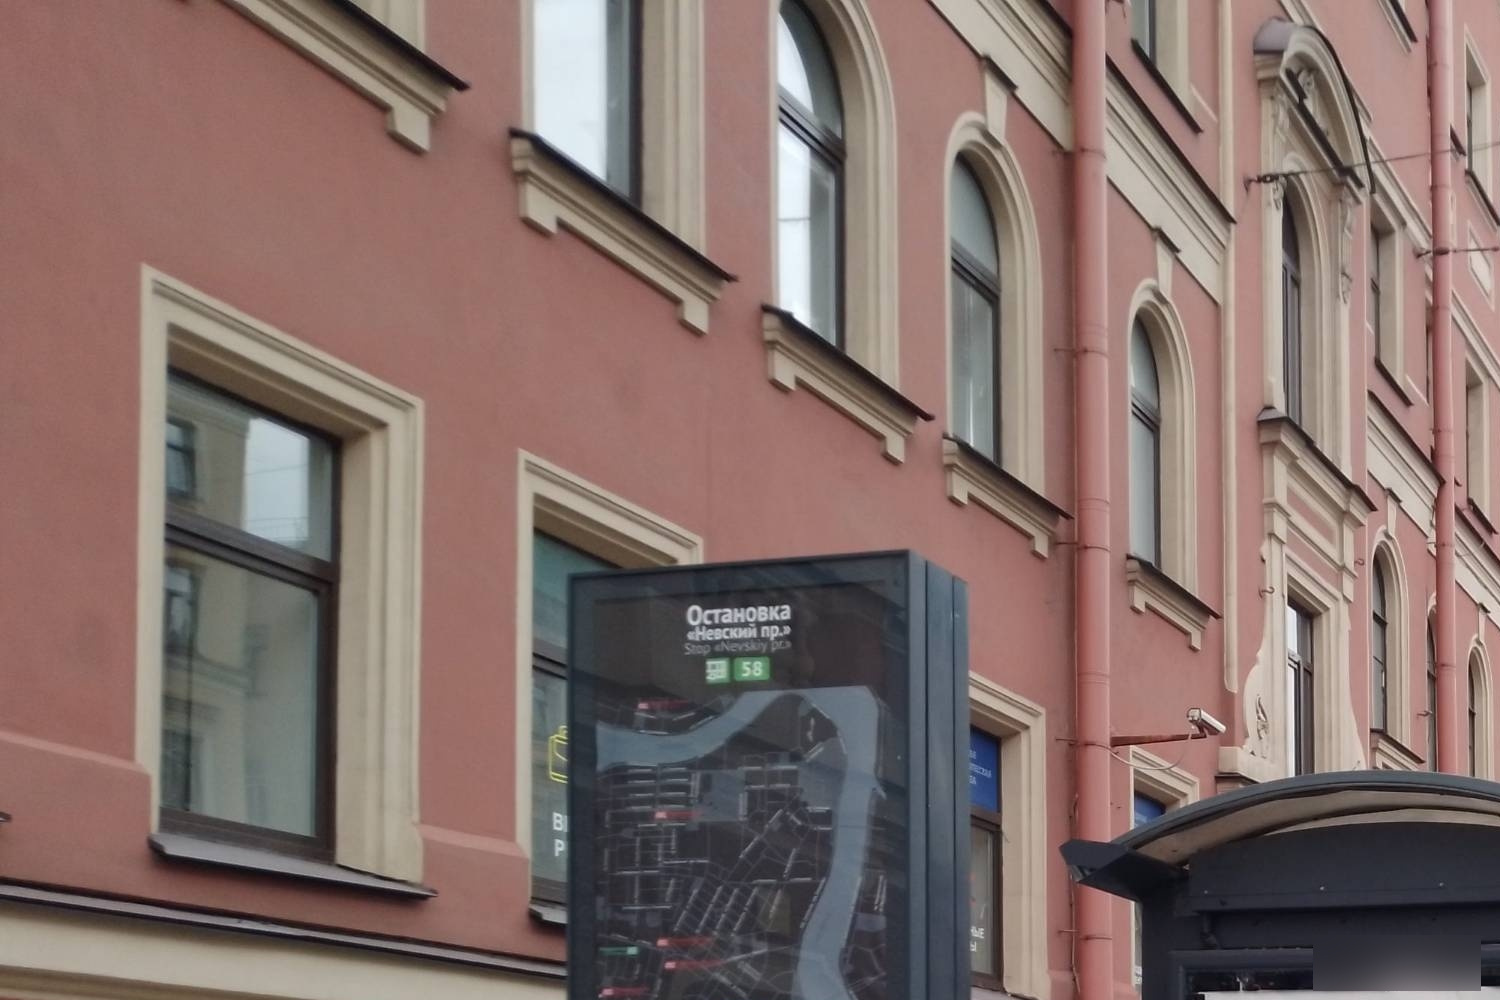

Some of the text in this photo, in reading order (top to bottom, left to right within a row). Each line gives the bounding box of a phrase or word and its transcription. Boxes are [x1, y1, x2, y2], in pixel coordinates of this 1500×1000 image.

[687, 604, 791, 626] Остановка
[687, 624, 791, 641] «Невский пр.»
[684, 642, 711, 655] Stop
[742, 661, 763, 677] 58
